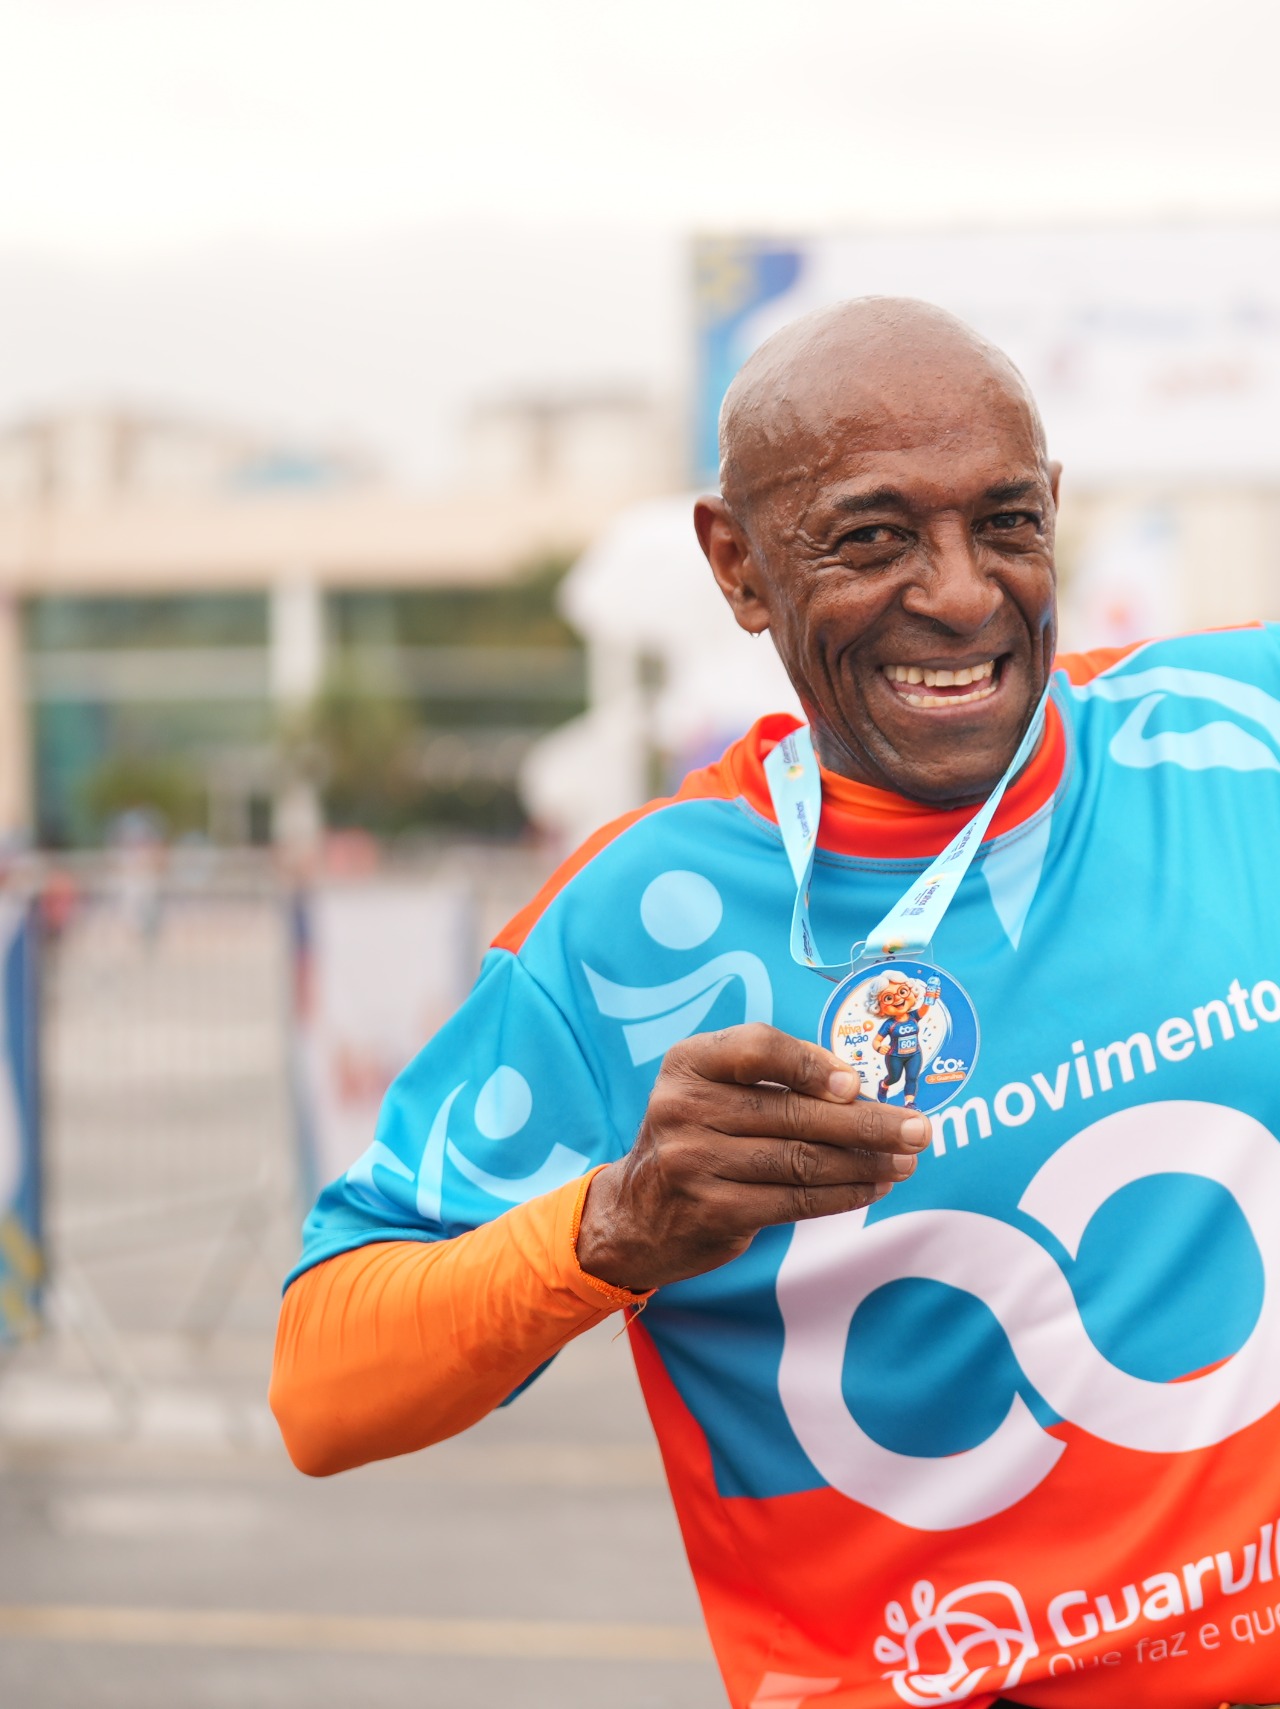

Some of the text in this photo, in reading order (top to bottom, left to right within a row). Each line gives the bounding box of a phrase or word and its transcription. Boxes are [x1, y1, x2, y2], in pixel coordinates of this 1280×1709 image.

[838, 1024, 862, 1038] Ativa
[844, 1034, 869, 1047] Ação
[1135, 1630, 1189, 1664] faz
[1200, 1622, 1221, 1651] e
